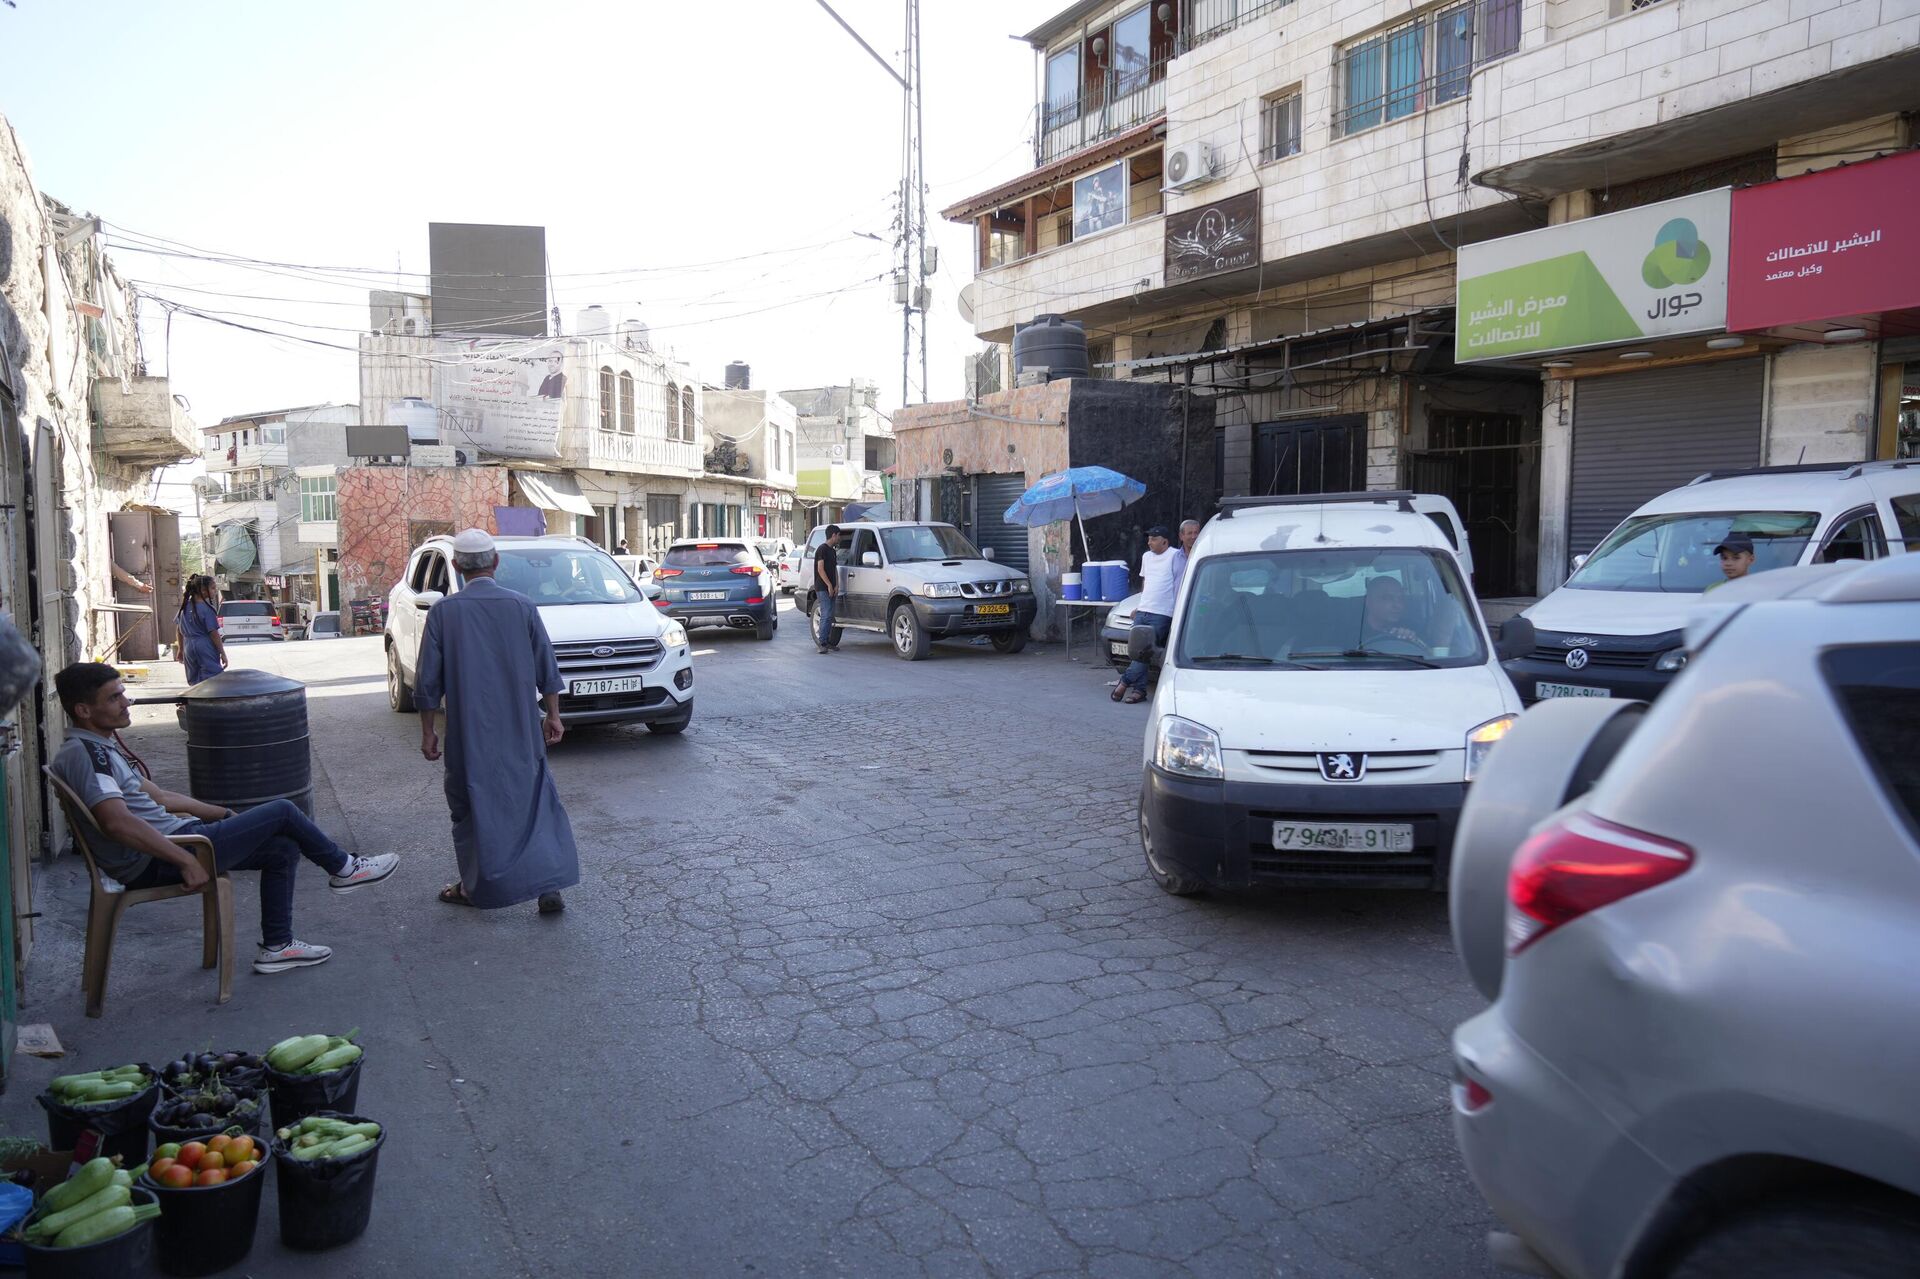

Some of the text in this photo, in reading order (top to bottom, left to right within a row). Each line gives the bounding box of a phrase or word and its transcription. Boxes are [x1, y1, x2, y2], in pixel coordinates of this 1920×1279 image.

[1766, 229, 1881, 262] البشير للاتصالات
[1765, 263, 1823, 281] وكيل معتمد
[1468, 294, 1568, 326] معرض البشير
[1647, 292, 1703, 320] جوال
[1468, 321, 1540, 348] للاتصالات
